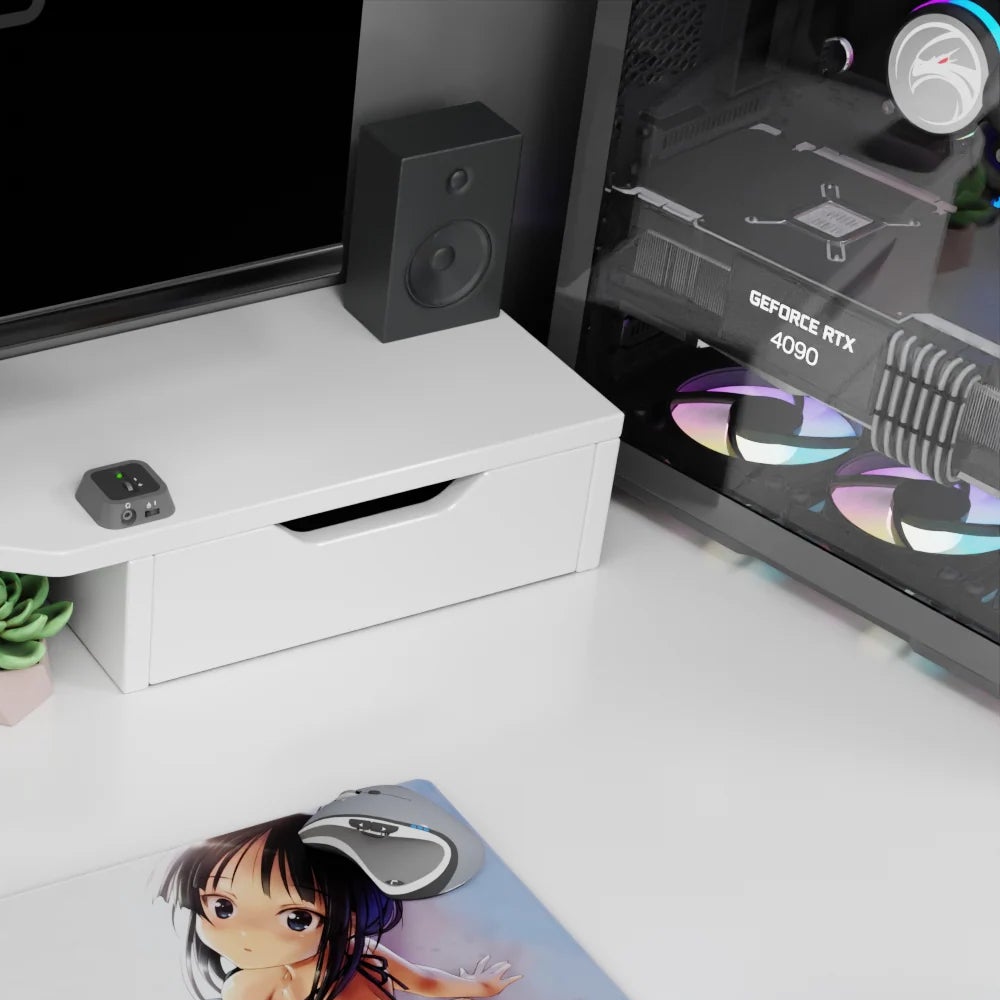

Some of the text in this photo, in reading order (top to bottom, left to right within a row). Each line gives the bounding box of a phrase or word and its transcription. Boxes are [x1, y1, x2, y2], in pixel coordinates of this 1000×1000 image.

[749, 289, 857, 354] GEFORCE RTX
[769, 331, 819, 367] 4090
